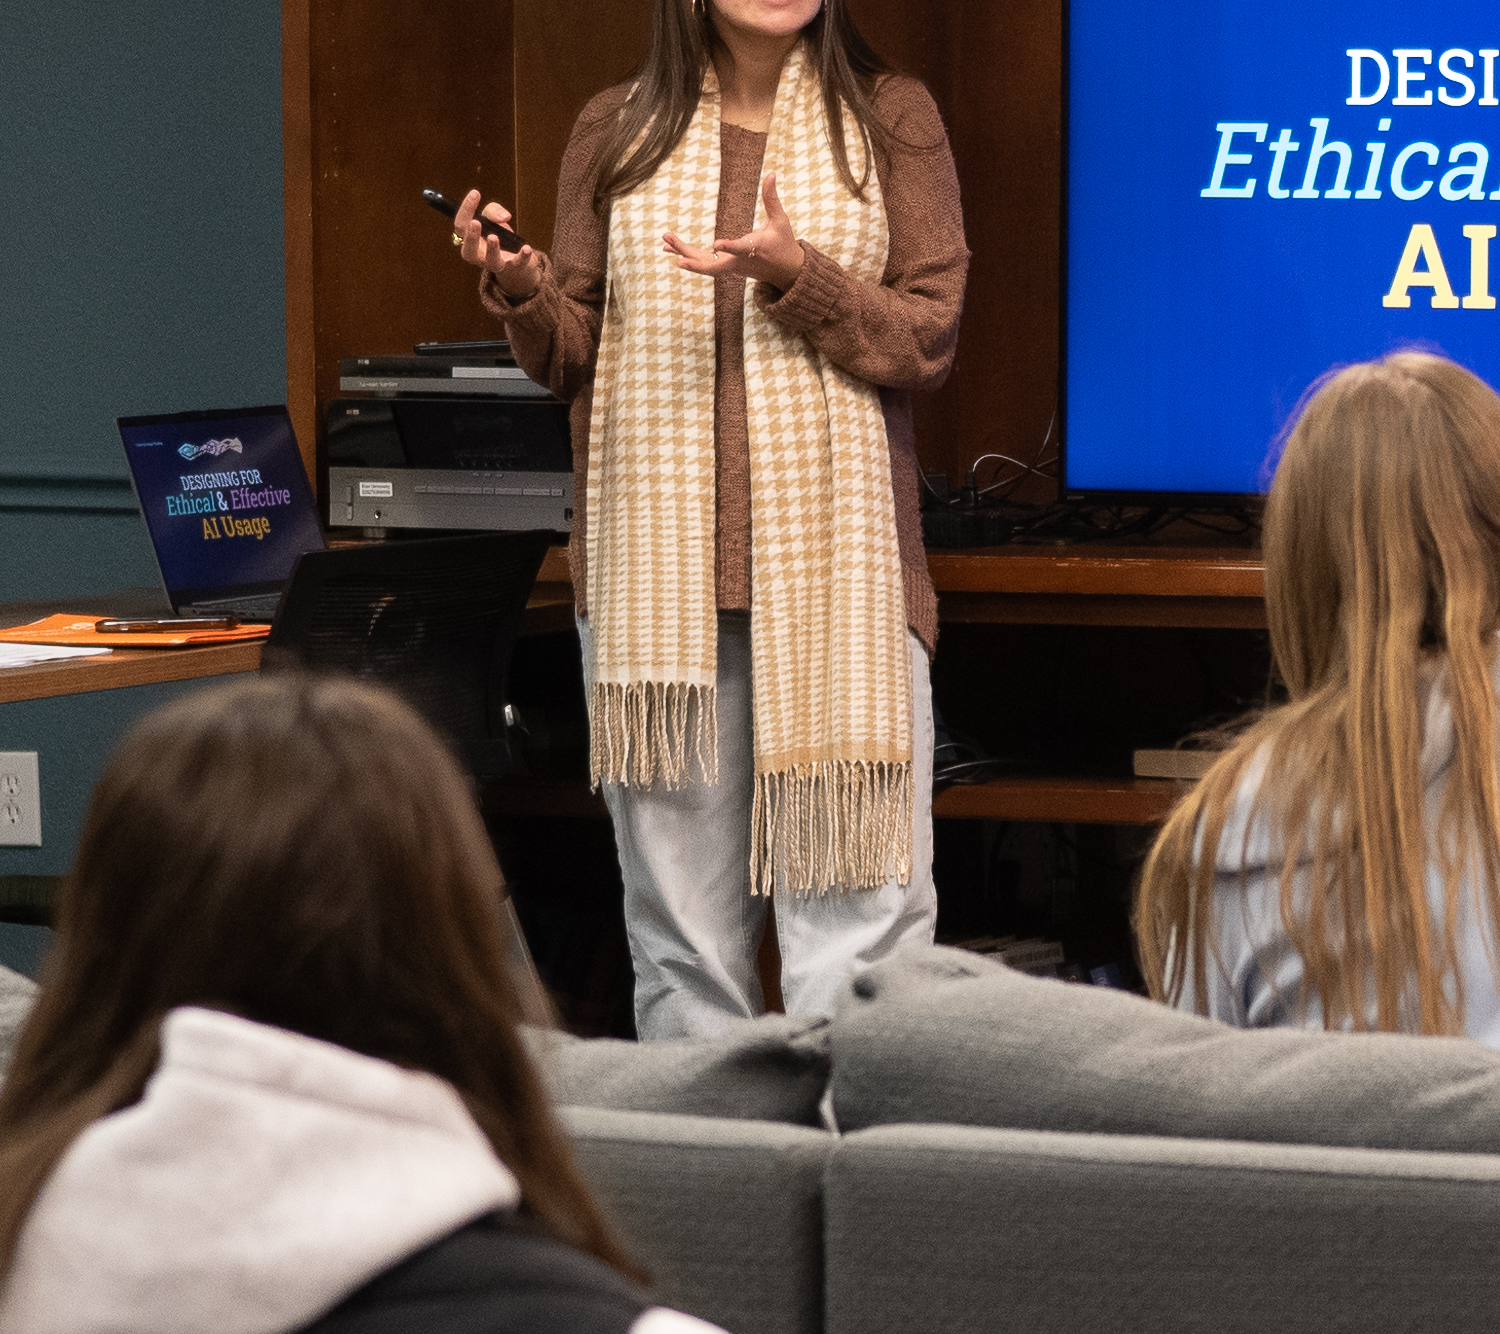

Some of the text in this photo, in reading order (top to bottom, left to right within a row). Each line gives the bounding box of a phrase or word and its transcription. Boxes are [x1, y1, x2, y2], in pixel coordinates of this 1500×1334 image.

[1382, 223, 1498, 310] AI
[179, 468, 263, 491] DESIGNING FOR
[165, 484, 291, 517] Ethical & Effective
[202, 515, 272, 540] AI Usage
